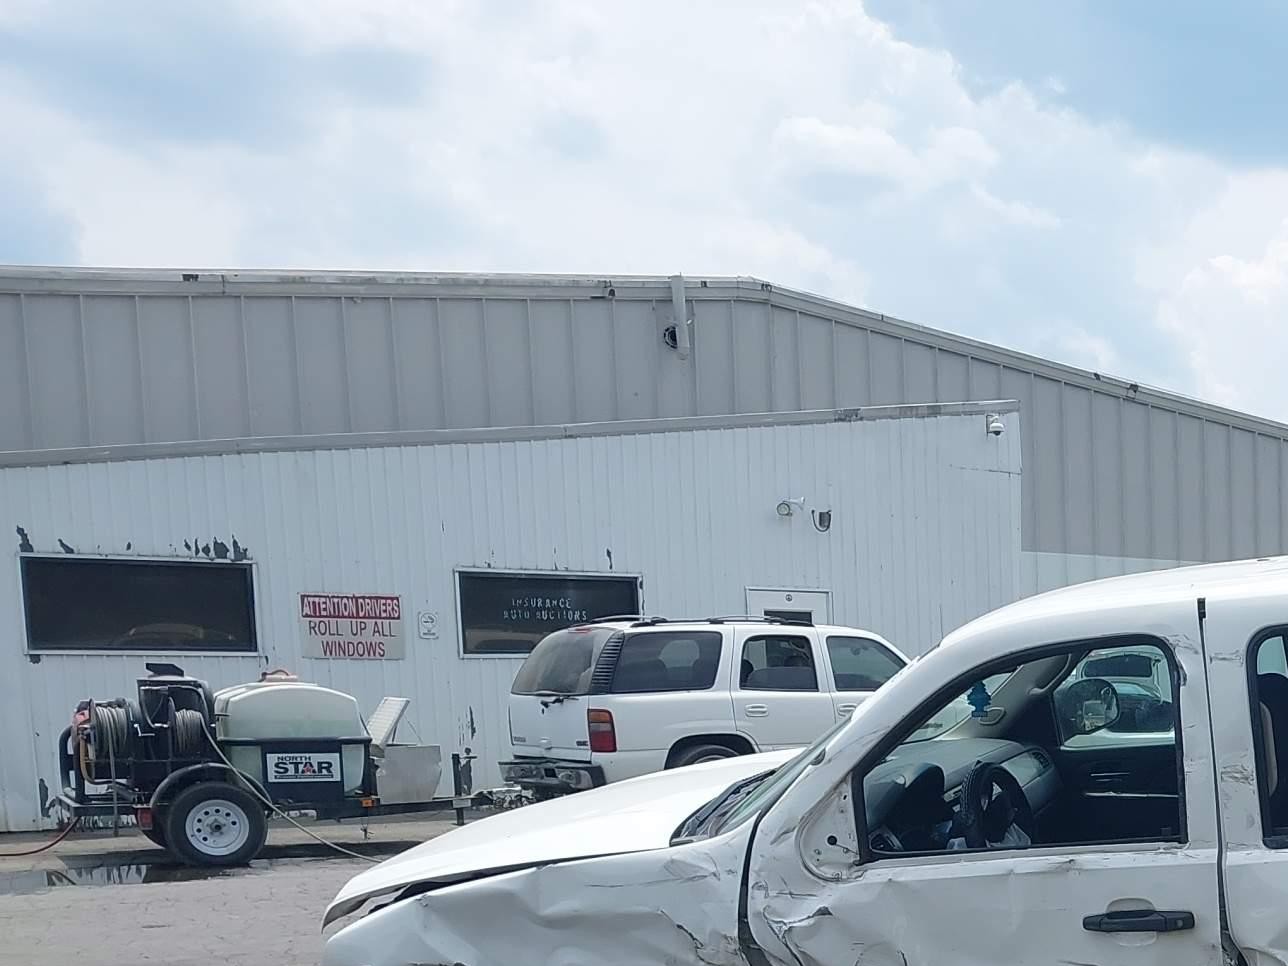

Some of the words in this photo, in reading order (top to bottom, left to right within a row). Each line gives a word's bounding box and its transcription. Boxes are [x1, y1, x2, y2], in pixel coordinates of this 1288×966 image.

[303, 597, 356, 617] ATTENTION
[358, 598, 399, 618] DRIVERS
[512, 598, 572, 609] INSURANCE
[309, 620, 344, 636] ROLL
[350, 621, 367, 637] UP
[372, 622, 397, 637] ALL
[321, 640, 386, 658] WINDOWS
[274, 761, 333, 775] STAR
